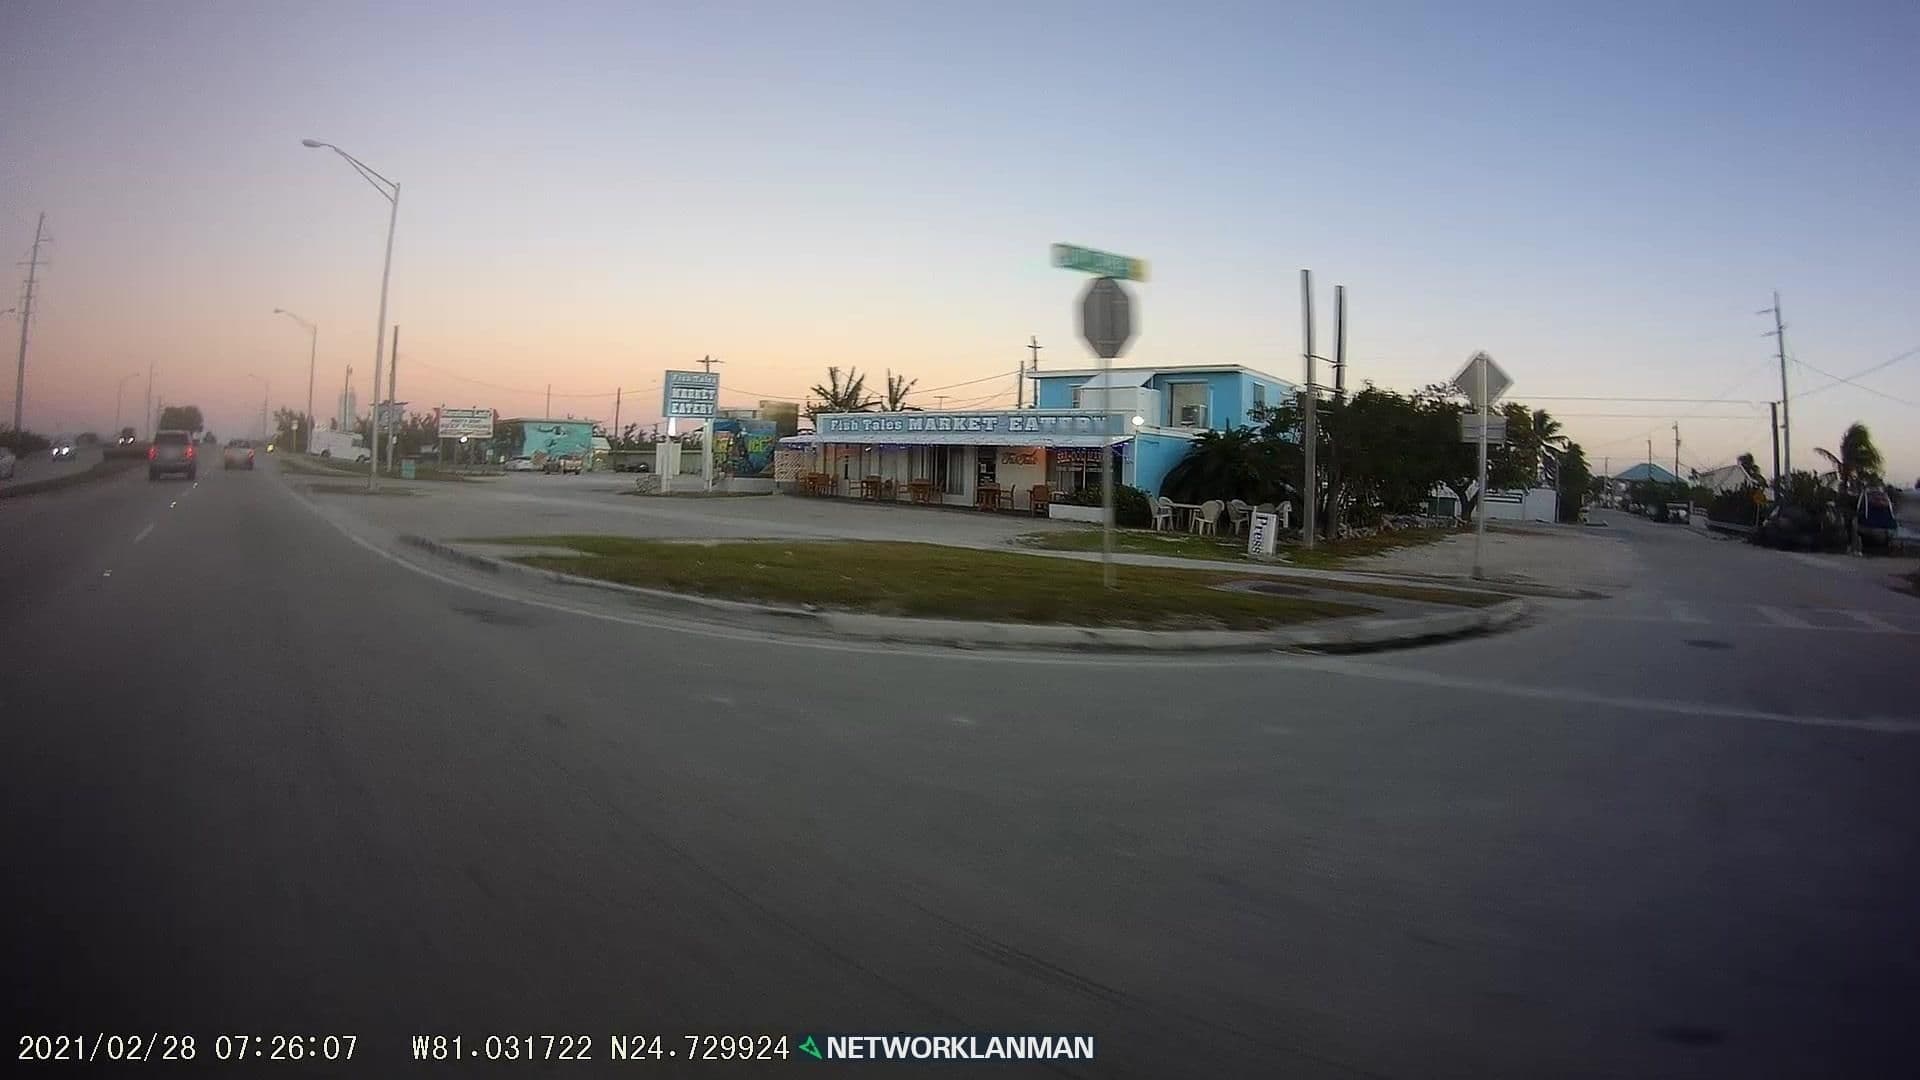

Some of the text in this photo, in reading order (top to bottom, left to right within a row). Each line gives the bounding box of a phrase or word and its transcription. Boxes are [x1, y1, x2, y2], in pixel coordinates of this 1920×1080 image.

[671, 388, 715, 400] MARKET
[671, 403, 714, 414] EATERY
[830, 420, 859, 431] Fish
[862, 419, 903, 431] Tales
[908, 417, 998, 432] MARKET
[1252, 516, 1268, 554] Press
